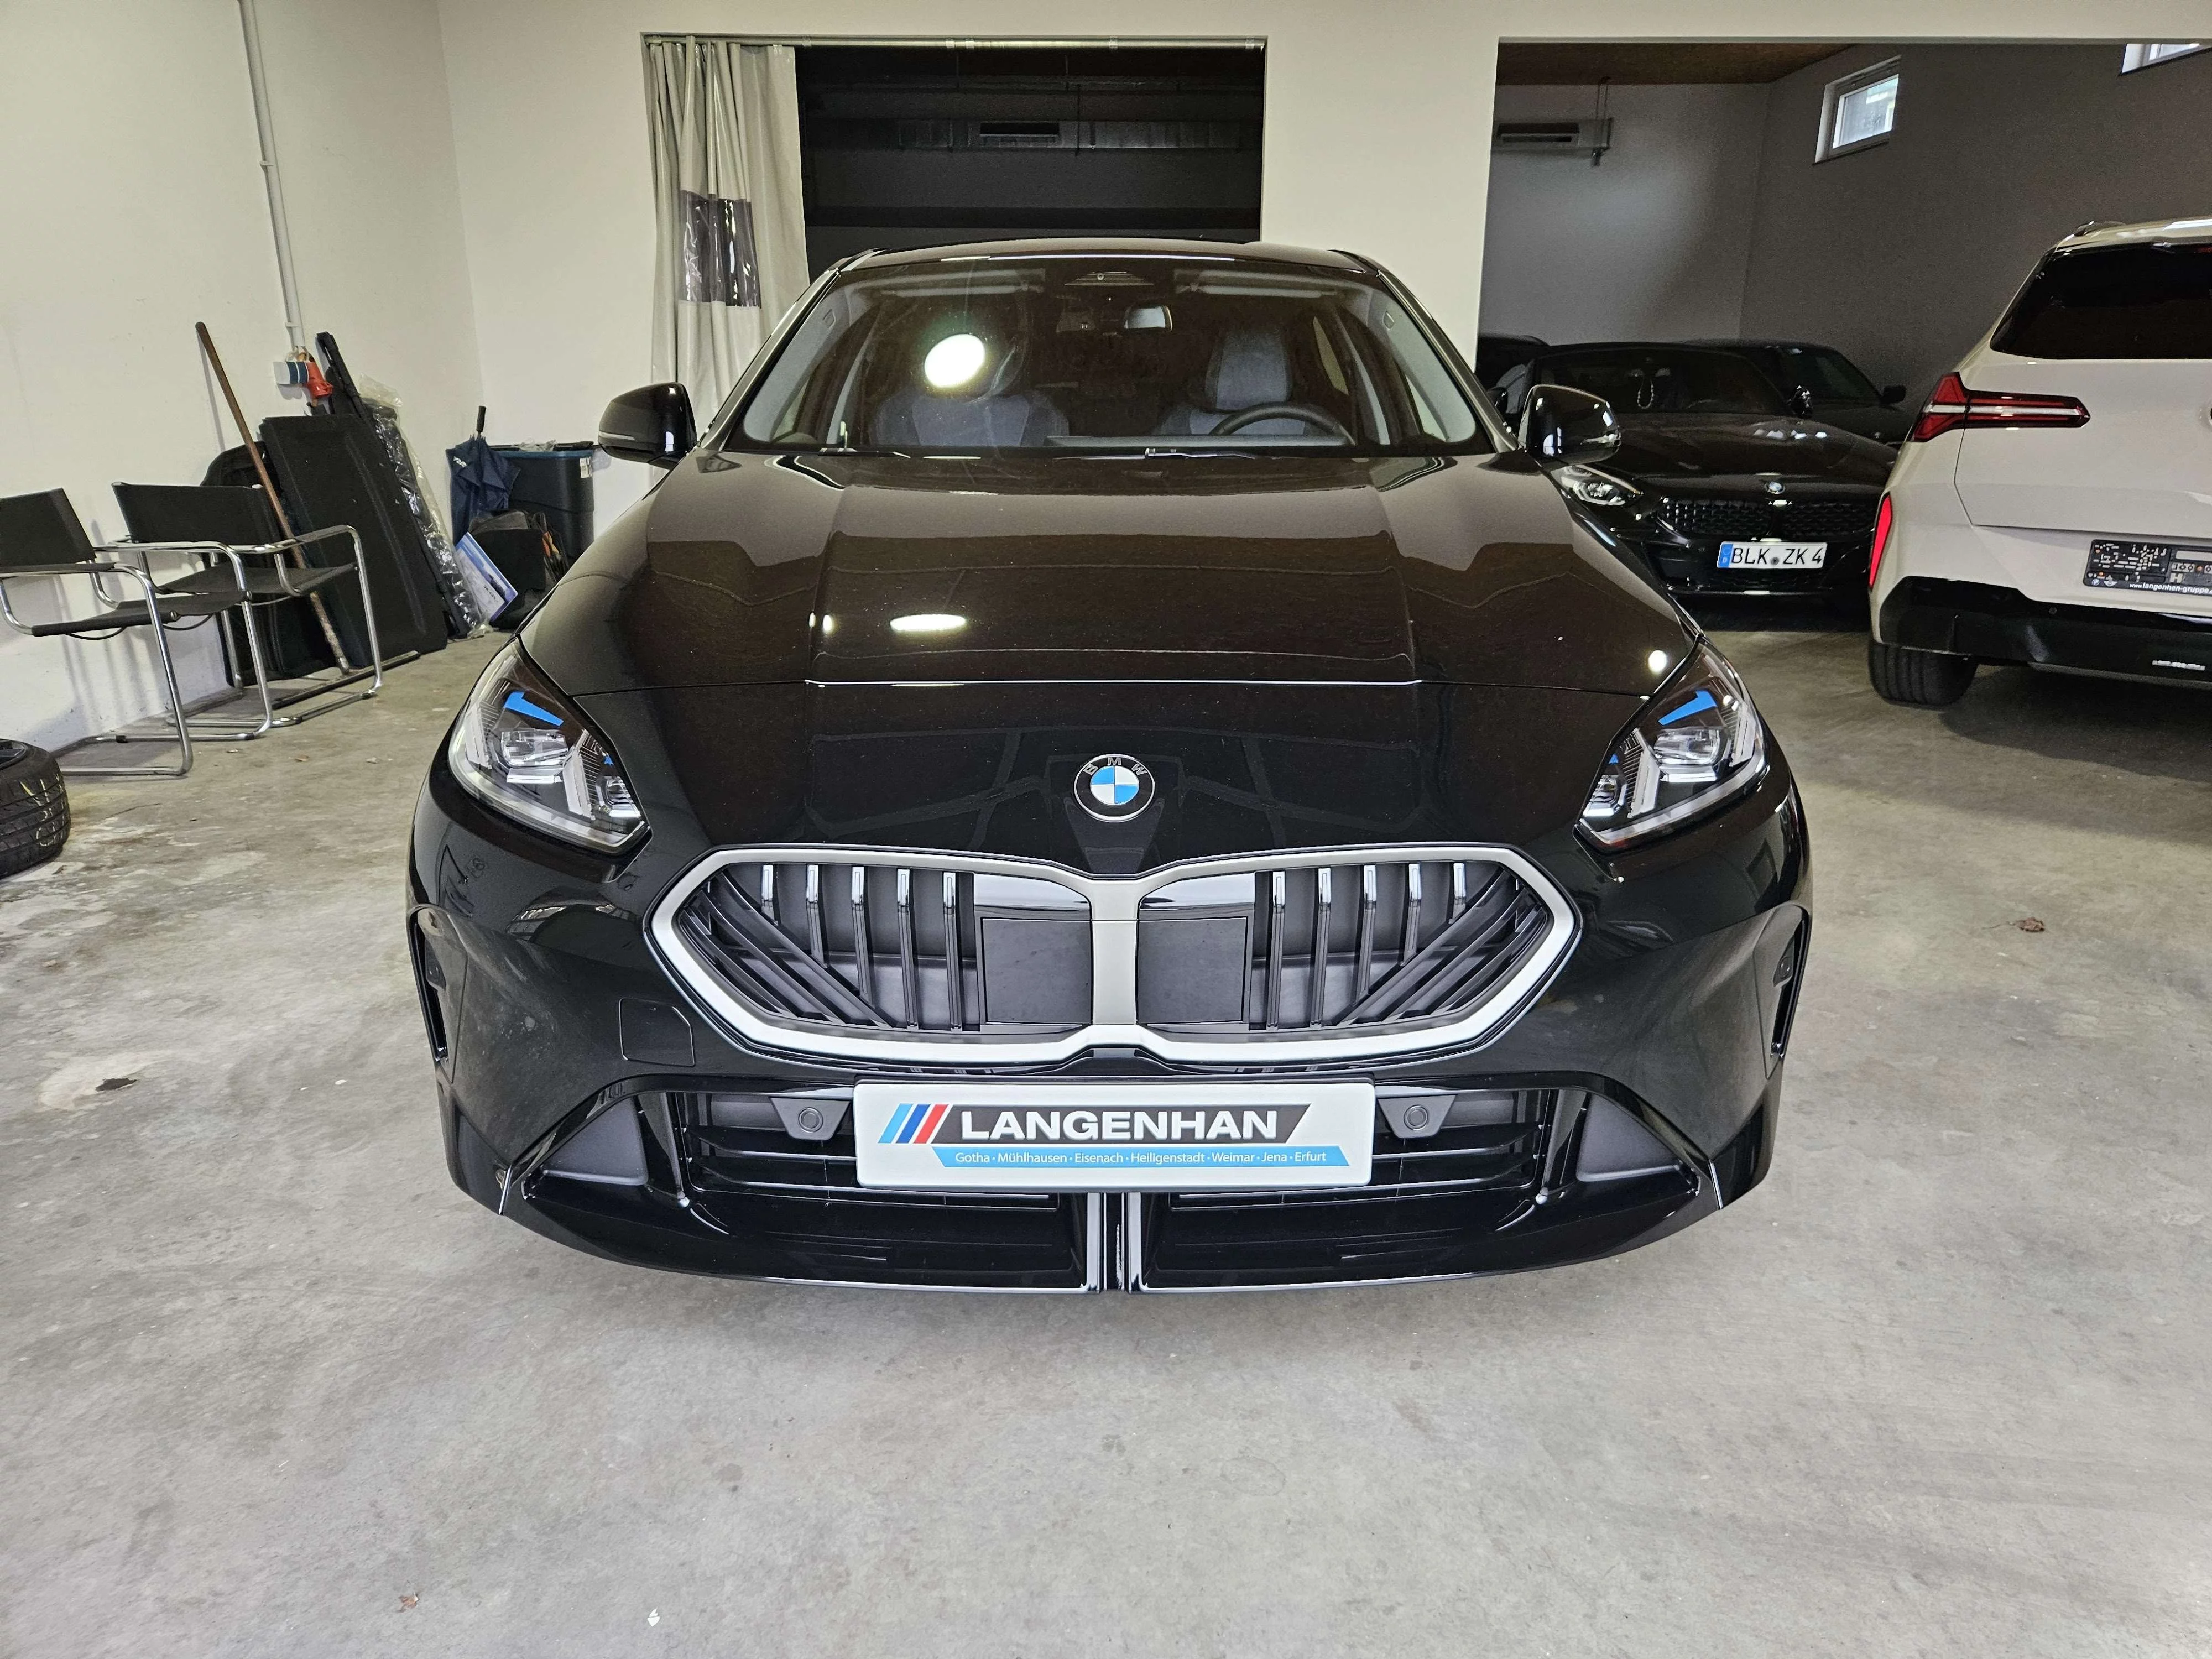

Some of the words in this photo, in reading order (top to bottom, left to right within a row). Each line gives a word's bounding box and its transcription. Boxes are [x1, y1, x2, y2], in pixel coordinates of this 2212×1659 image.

[1731, 547, 1771, 565] BLK
[1782, 548, 1808, 565] ZK
[1812, 547, 1823, 564] 4
[1083, 757, 1147, 775] BMW
[961, 1110, 1277, 1140] LANGENHAN
[955, 1152, 990, 1162] Gotha
[998, 1152, 1067, 1162] Mühlhausen
[1074, 1152, 1123, 1162] Eisenach
[1131, 1152, 1205, 1165] Heiligenstadt
[1212, 1152, 1255, 1162] Weimar
[1261, 1152, 1288, 1162] Jena
[1295, 1151, 1327, 1162] Erfurt
